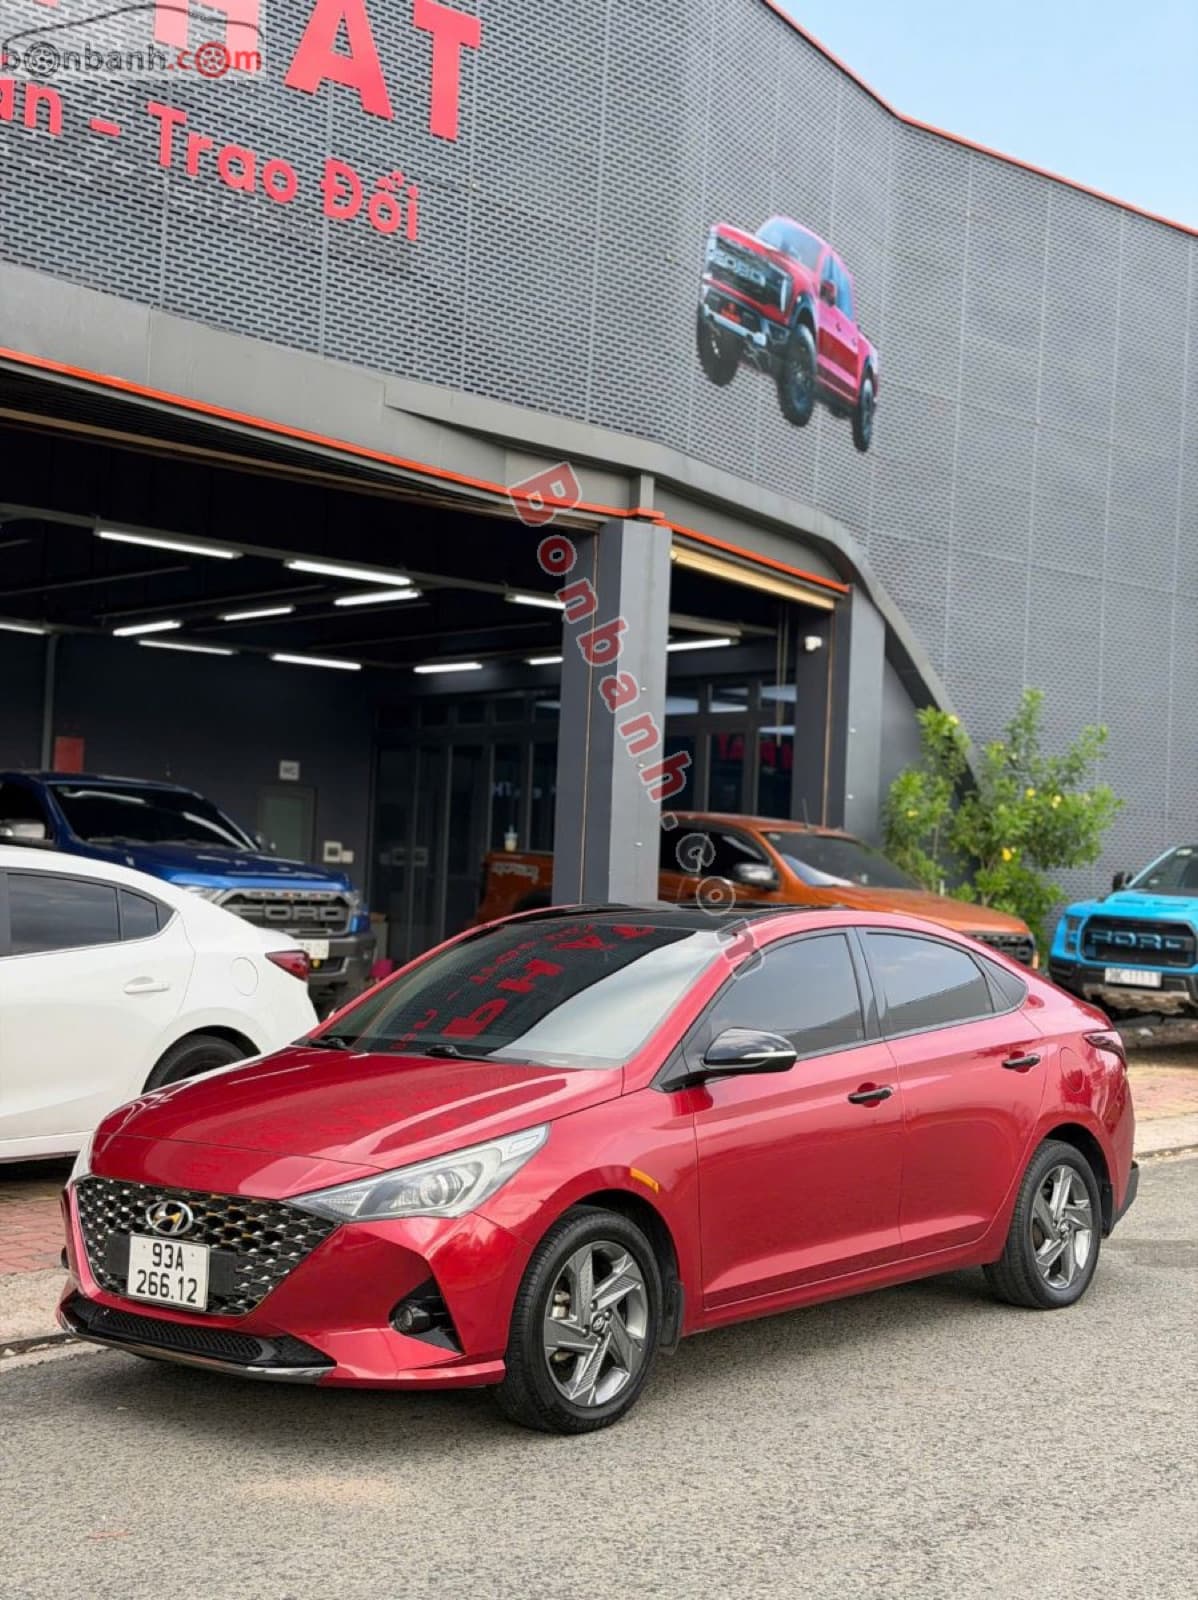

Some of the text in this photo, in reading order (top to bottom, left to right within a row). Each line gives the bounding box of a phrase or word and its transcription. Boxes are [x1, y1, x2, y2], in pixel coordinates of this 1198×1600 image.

[147, 101, 298, 204] Trao
[320, 157, 419, 242] Đổi
[152, 1242, 184, 1271] 93A
[136, 1269, 197, 1303] 266.12
